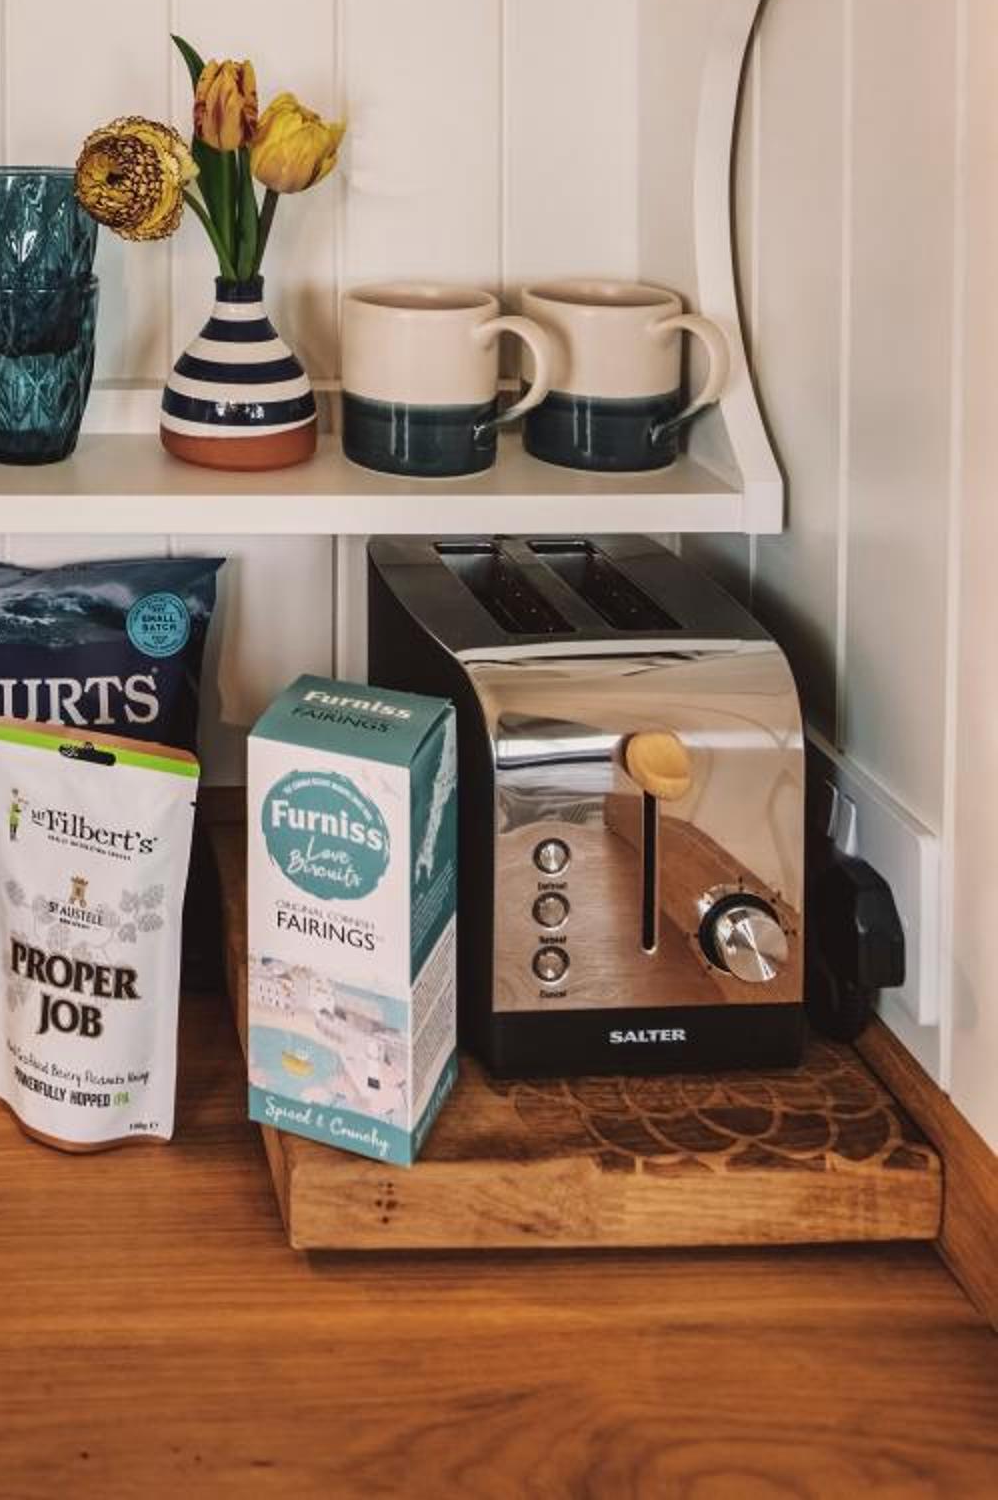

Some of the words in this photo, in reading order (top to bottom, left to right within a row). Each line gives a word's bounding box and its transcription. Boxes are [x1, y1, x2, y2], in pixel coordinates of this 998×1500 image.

[291, 707, 389, 733] FAIRINGS
[303, 690, 411, 719] Furniss
[46, 809, 154, 855] Filbert's
[271, 799, 383, 851] Furniss
[286, 848, 362, 887] Biscuits
[306, 835, 350, 864] Love
[277, 910, 375, 951] FAIRINGS
[10, 936, 141, 999] PROPER
[36, 991, 103, 1039] JOB
[609, 1028, 686, 1044] SALTER
[69, 1089, 111, 1108] HOPPED
[265, 1095, 312, 1125] Spiced
[329, 1116, 390, 1157] Crunchy
